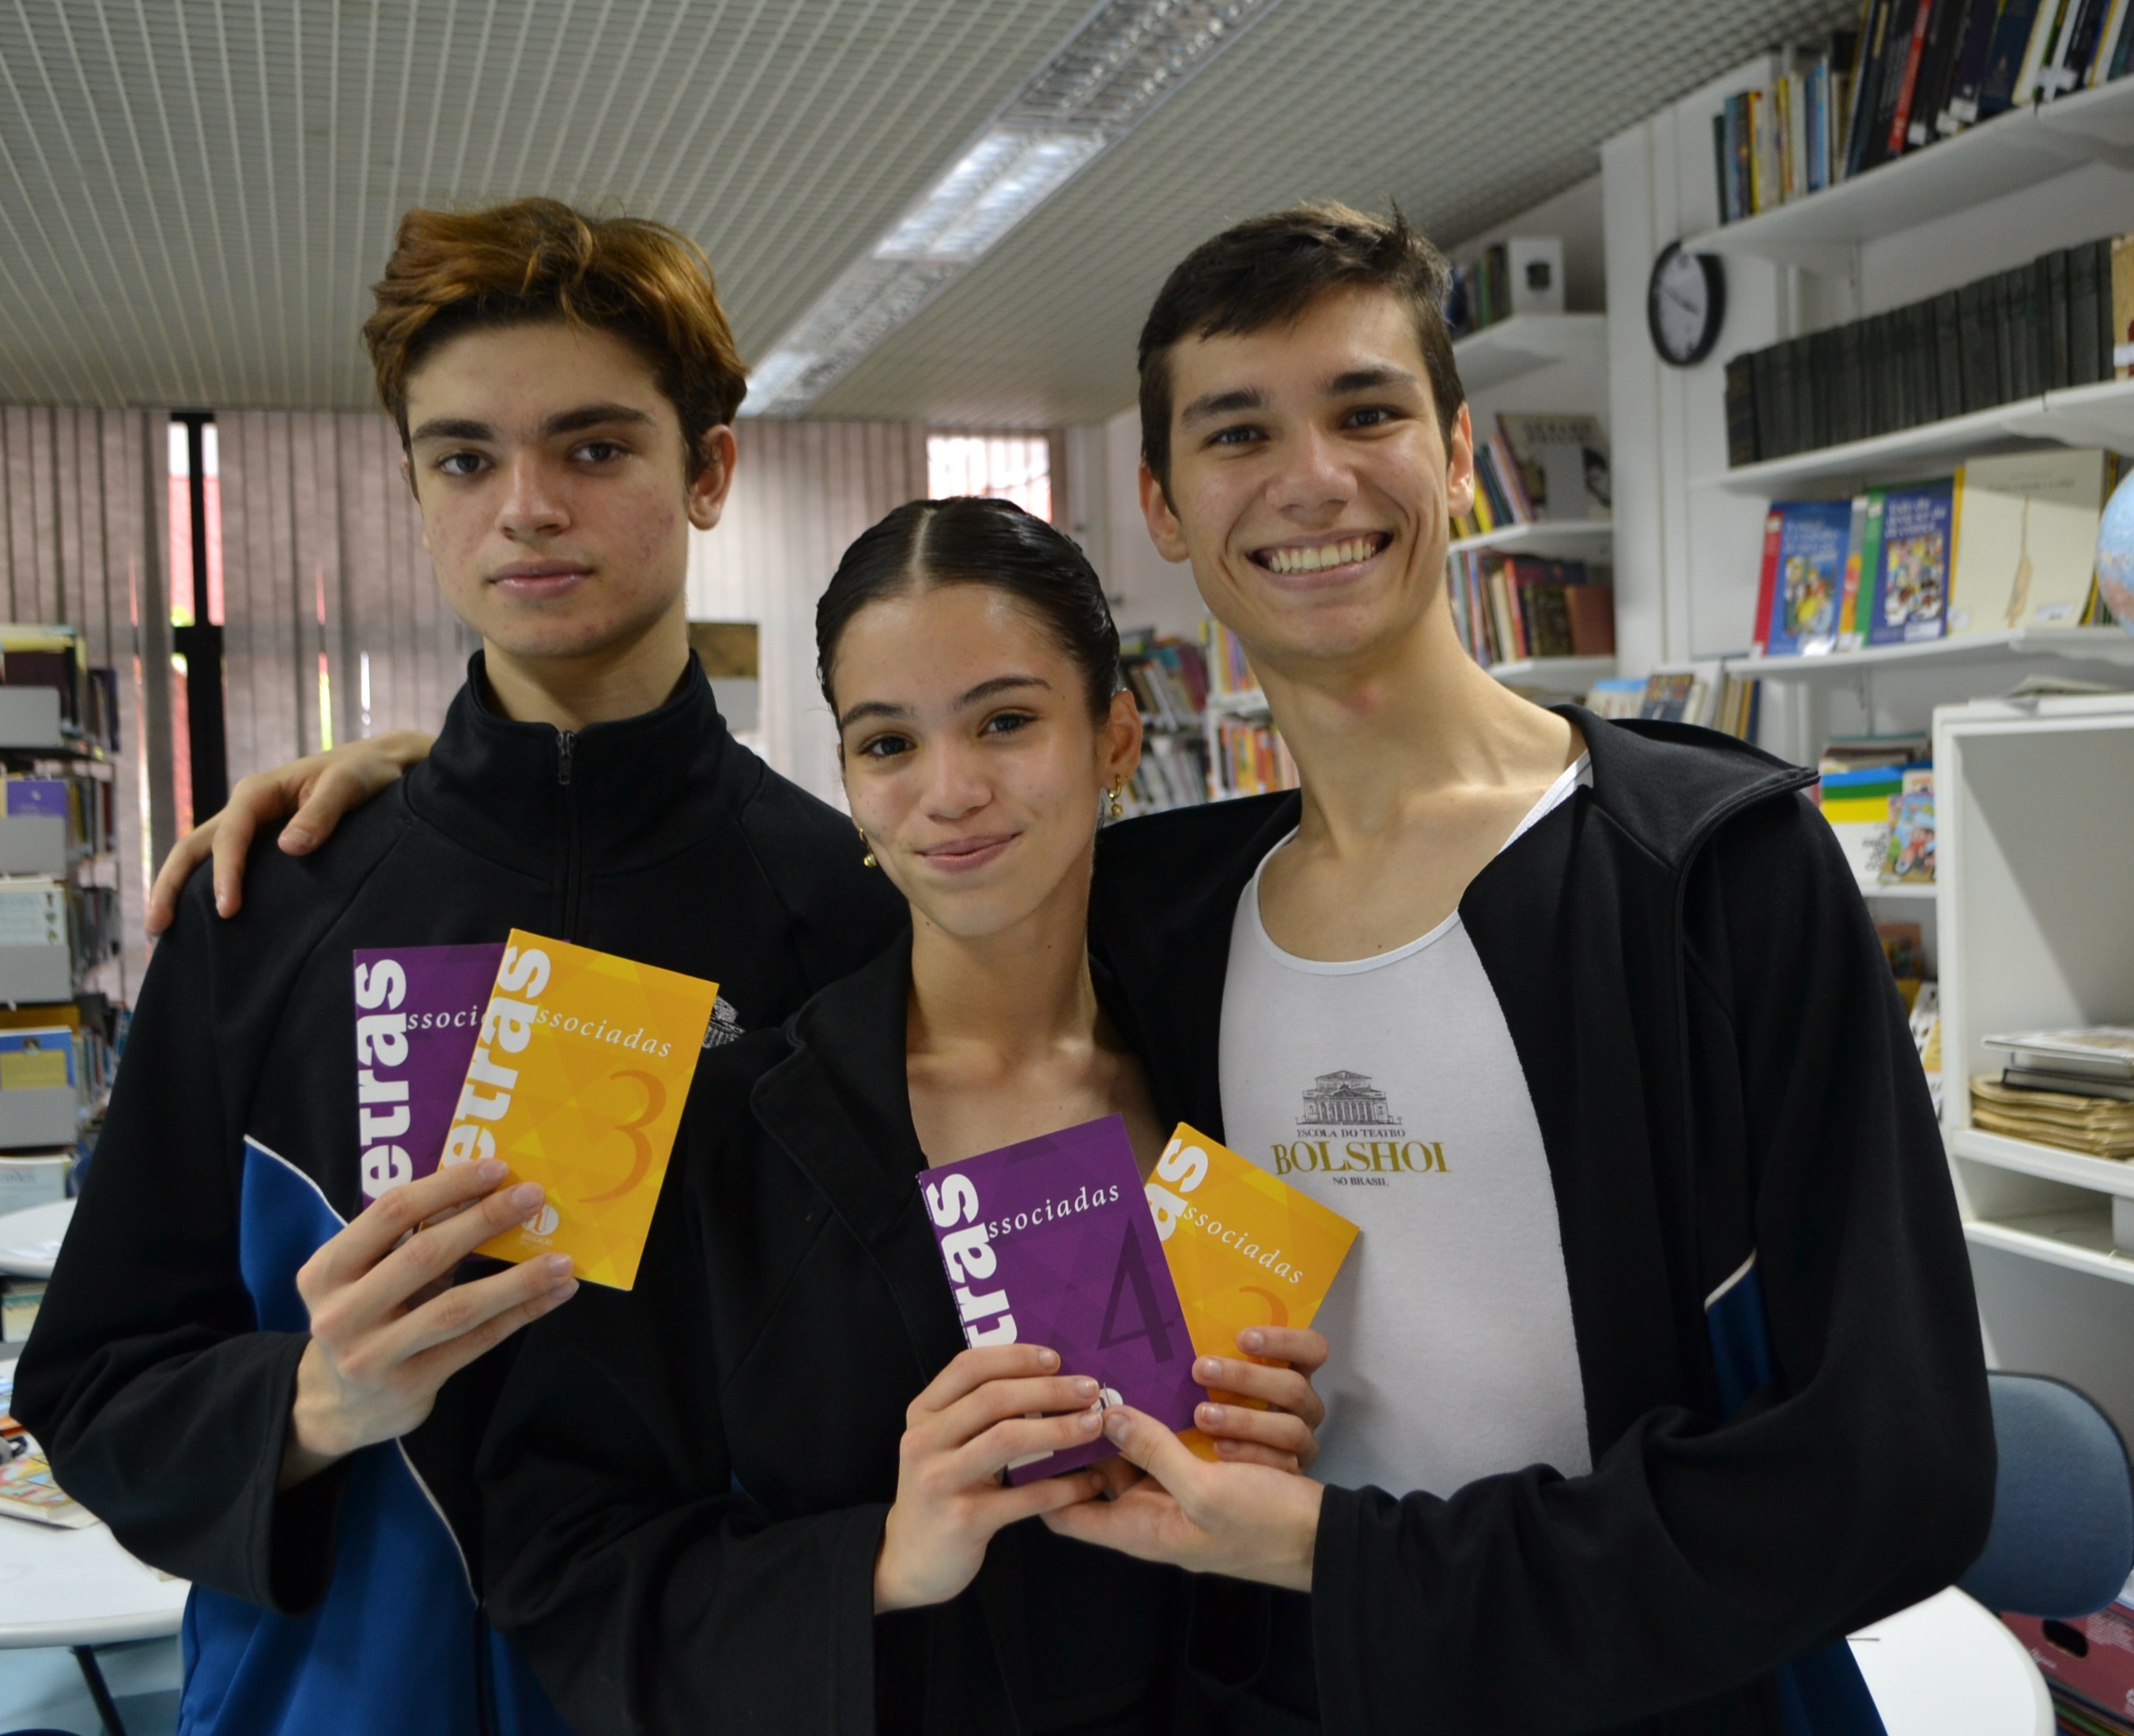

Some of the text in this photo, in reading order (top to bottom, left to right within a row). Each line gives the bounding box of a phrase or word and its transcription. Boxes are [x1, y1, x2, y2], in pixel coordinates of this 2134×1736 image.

[407, 1004, 485, 1030] ssoci
[535, 1006, 672, 1058] ssociadas
[354, 959, 414, 1202] etras
[440, 945, 551, 1170] etras
[578, 1069, 667, 1204] 3
[1271, 1140, 1452, 1176] BOLSHOI
[1297, 1128, 1406, 1138] ESCOLA DO TEATRO
[1332, 1176, 1389, 1187] NO BRASIL
[988, 1185, 1120, 1239] ssociadas
[1183, 1206, 1303, 1284] ssociadas
[1096, 1213, 1176, 1364] 4
